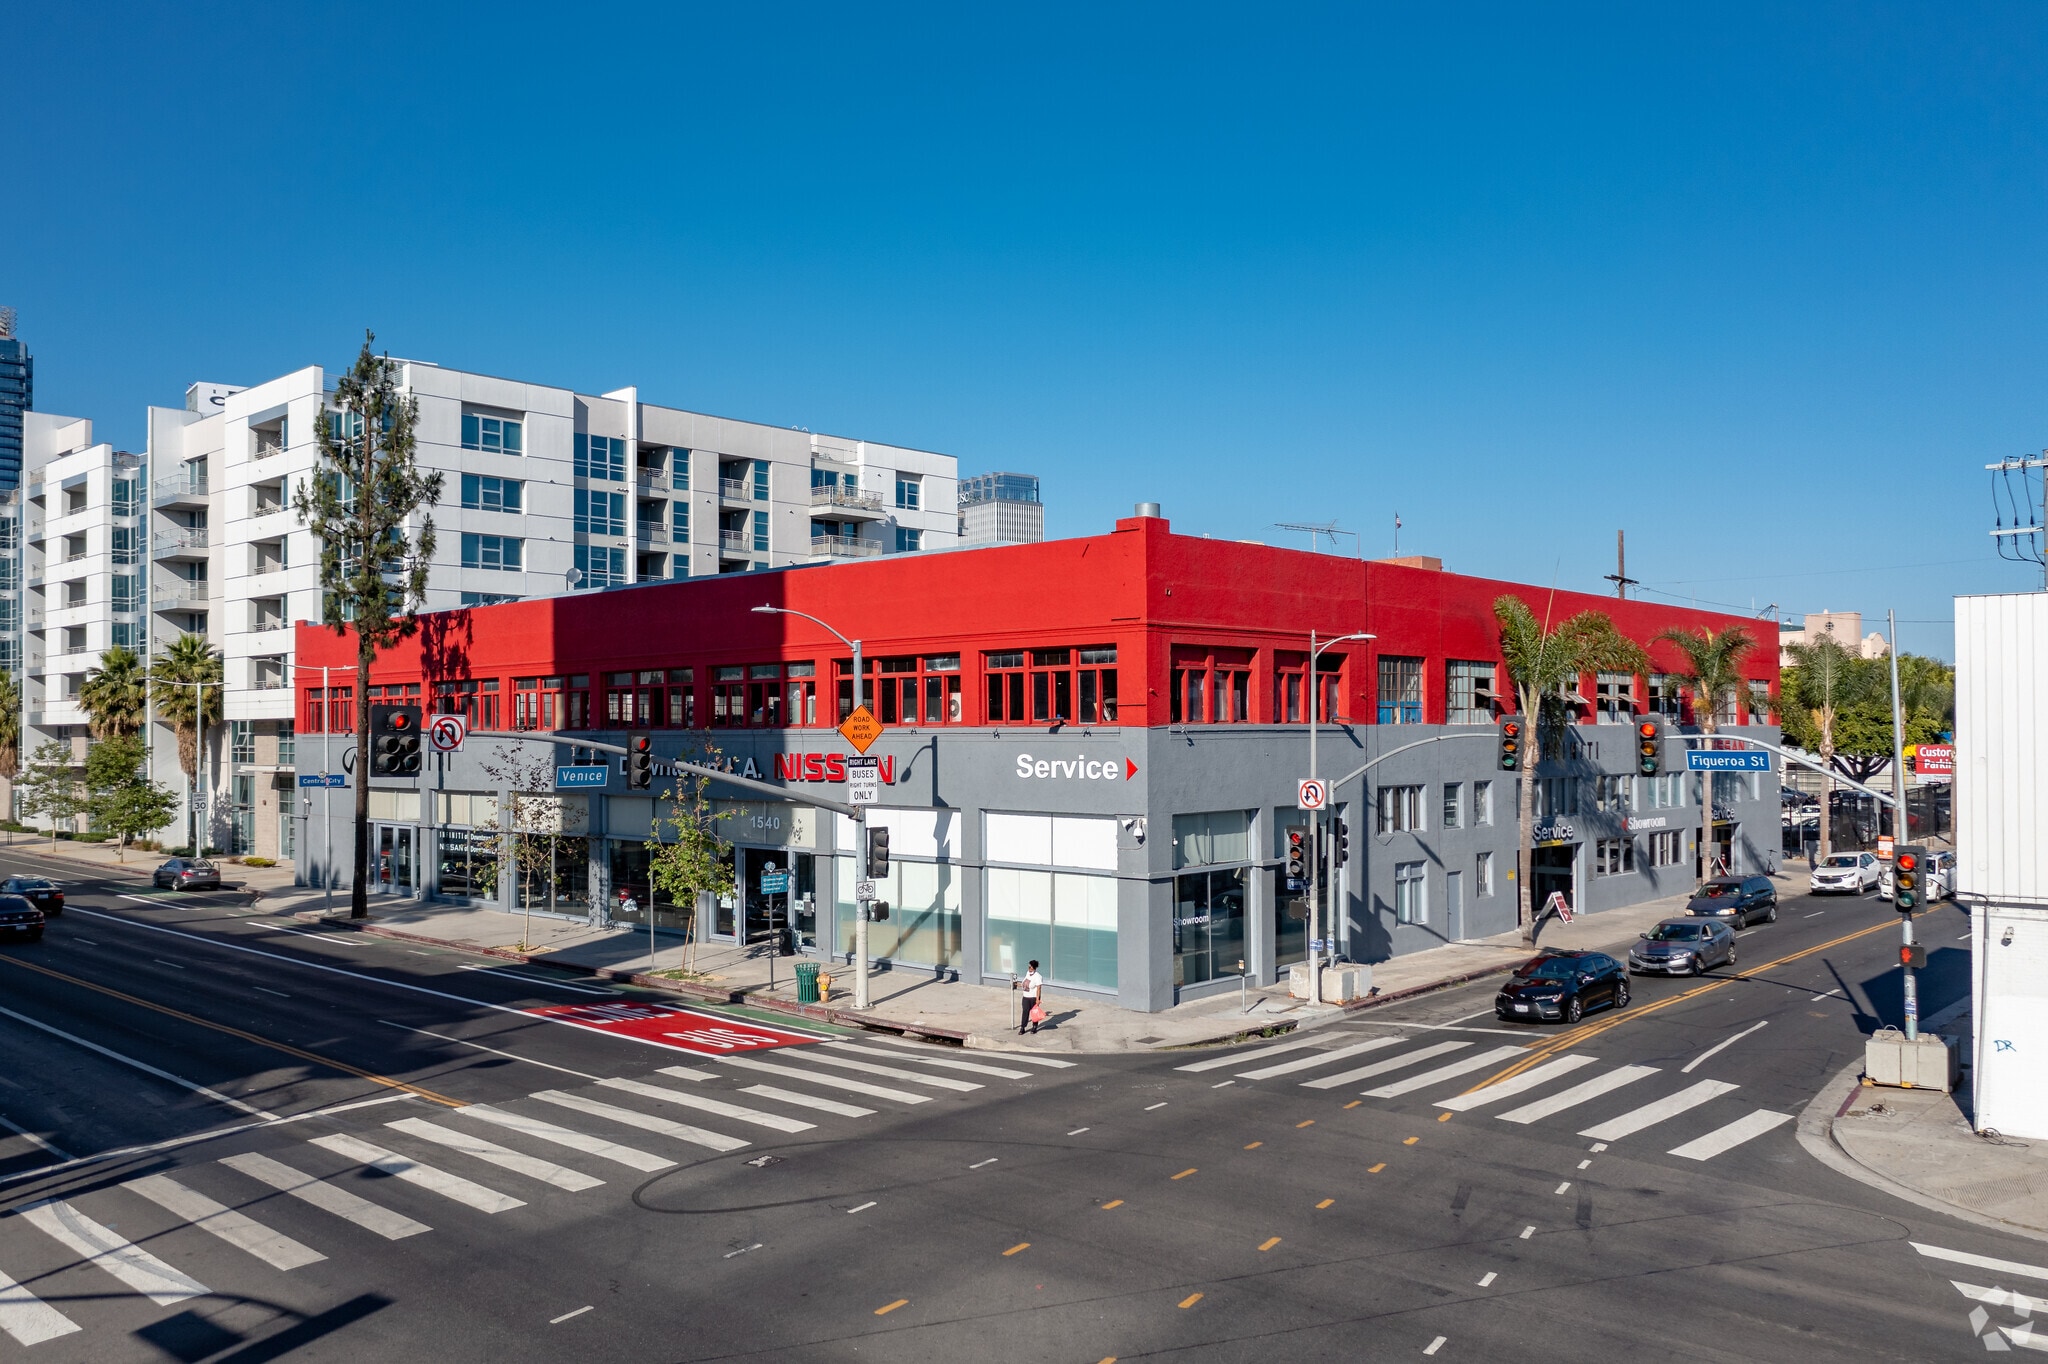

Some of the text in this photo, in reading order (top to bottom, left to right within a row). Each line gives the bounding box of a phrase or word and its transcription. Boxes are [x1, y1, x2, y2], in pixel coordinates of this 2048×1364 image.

[774, 753, 893, 784] NISSN
[1015, 753, 1119, 780] Service
[1691, 755, 1765, 769] Figueroa St
[328, 777, 342, 785] City
[562, 770, 602, 782] Venice
[852, 770, 874, 778] BUSES
[853, 790, 873, 800] ONLY
[194, 801, 207, 810] 30
[1711, 806, 1735, 820] ervice
[750, 815, 780, 830] 1540
[1627, 816, 1667, 830] Showroom
[1533, 823, 1574, 840] Service
[1173, 913, 1209, 926] Showroom
[545, 1003, 675, 1025] LANE
[662, 1028, 779, 1049] BUS
